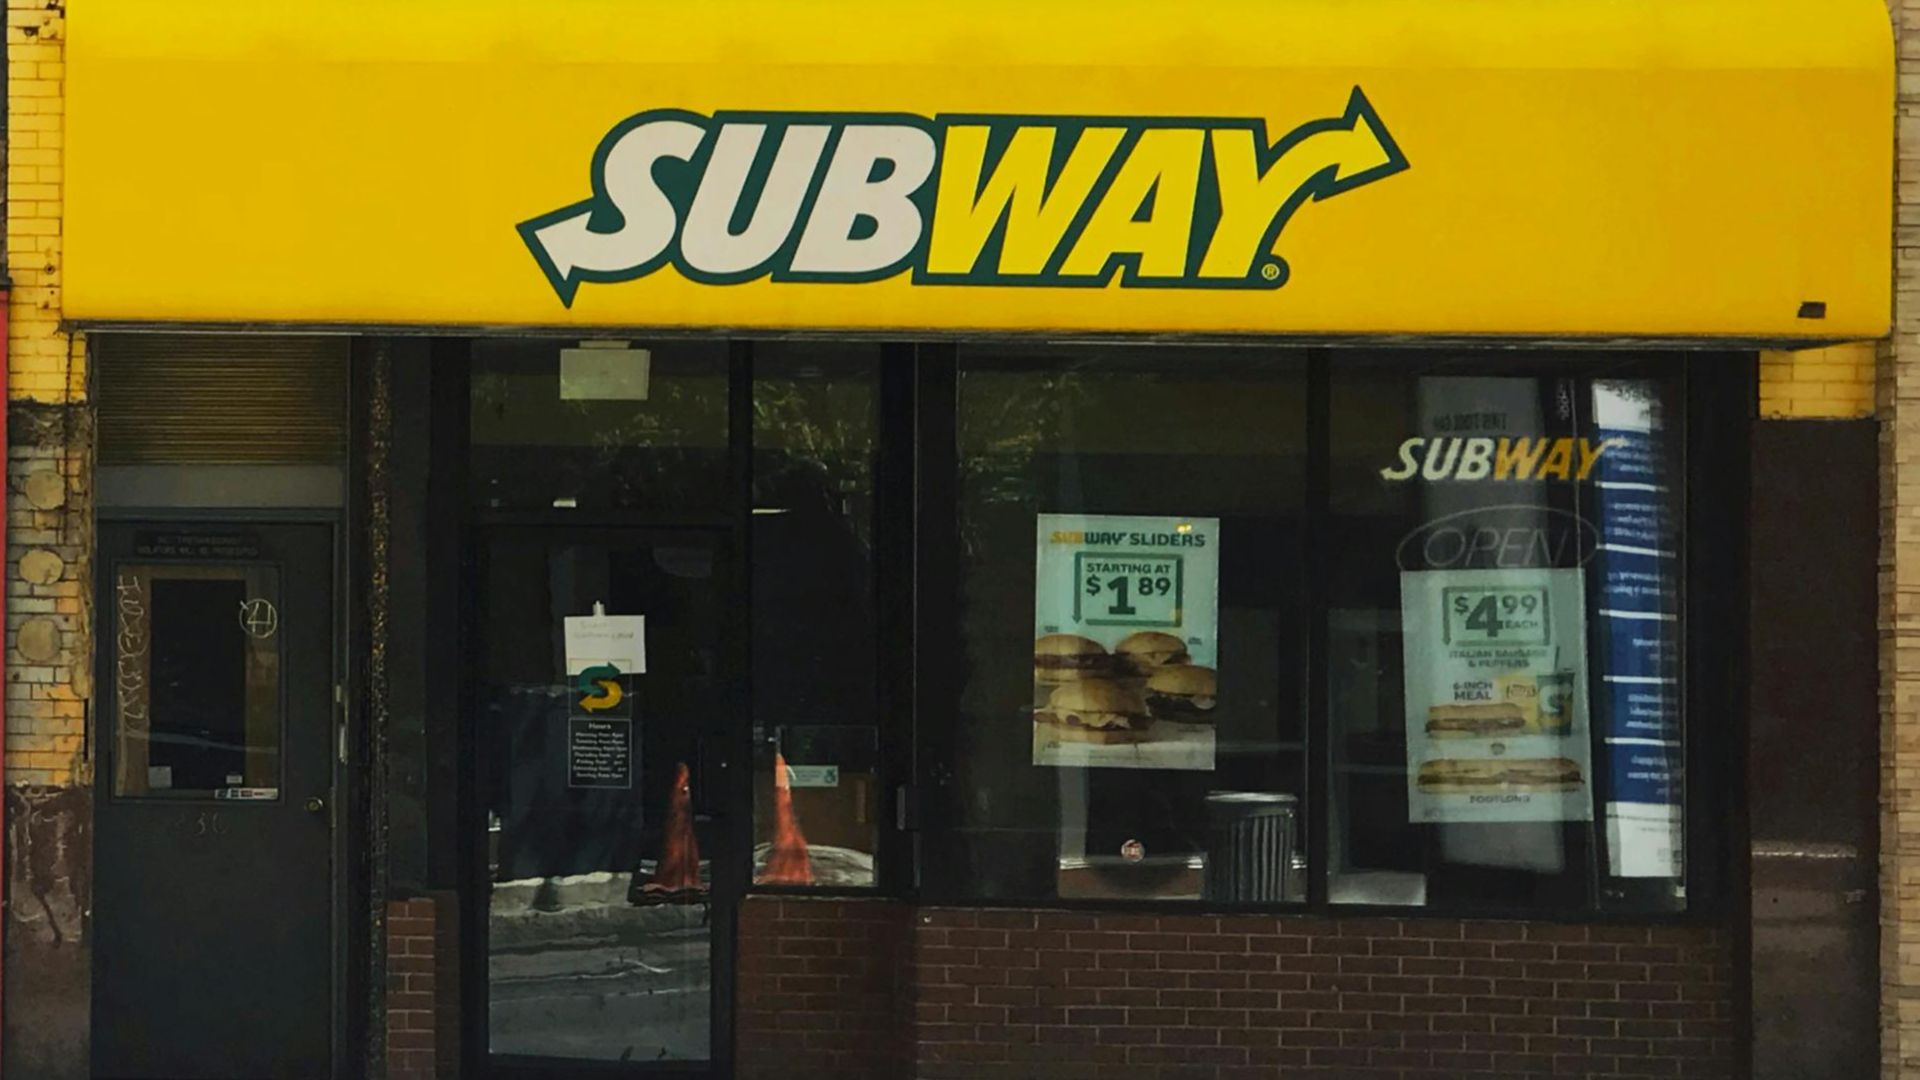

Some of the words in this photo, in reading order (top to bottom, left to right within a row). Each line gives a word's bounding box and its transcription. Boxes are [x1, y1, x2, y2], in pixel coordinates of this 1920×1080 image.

[532, 103, 1398, 284] SUBWAY
[1381, 436, 1629, 481] SUBWAY
[1050, 531, 1126, 544] SUBWAY
[1130, 533, 1206, 547] SLIDERS
[1424, 527, 1568, 567] OPEN
[1086, 562, 1151, 574] STARTING
[1154, 563, 1171, 574] AT
[1505, 620, 1538, 630] EACH
[1449, 648, 1492, 658] ITALIAN
[1453, 681, 1493, 691] 6-INCH
[1454, 690, 1492, 701] MEAL
